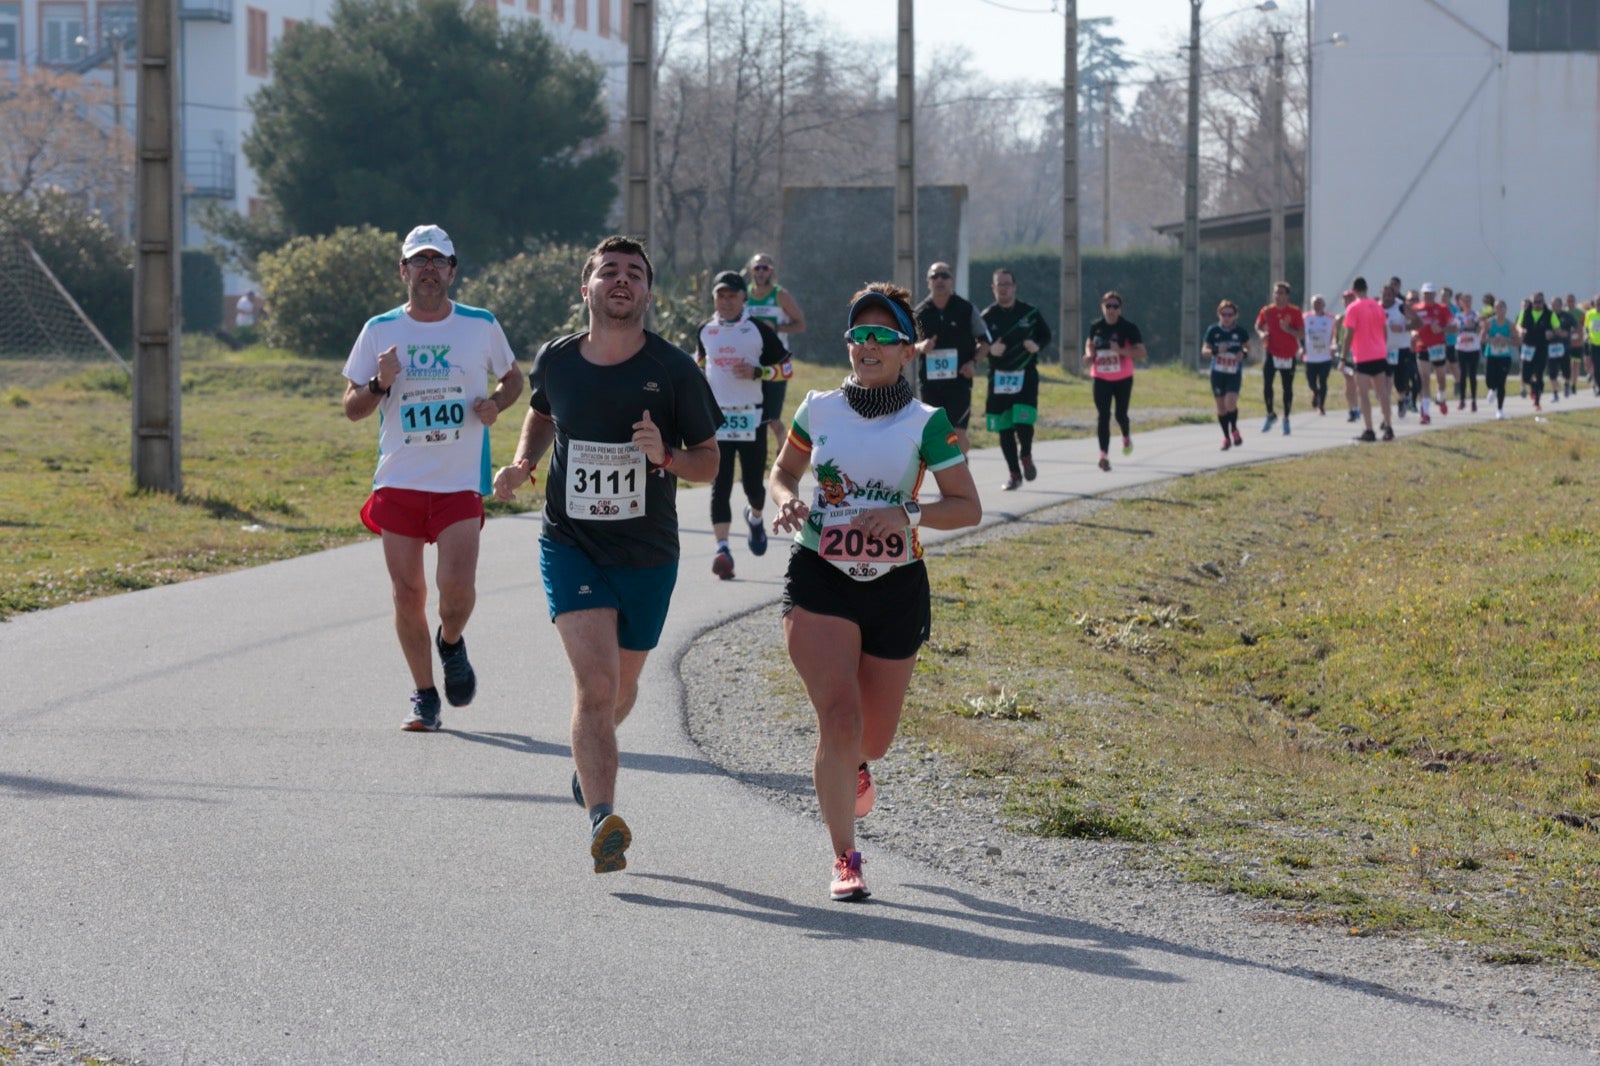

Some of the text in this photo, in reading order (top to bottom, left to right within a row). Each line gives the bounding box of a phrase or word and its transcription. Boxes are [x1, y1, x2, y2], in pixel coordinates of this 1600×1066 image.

[935, 359, 949, 369] 50
[405, 403, 464, 429] 1140
[574, 468, 635, 494] 3111
[866, 480, 881, 489] LA
[844, 508, 859, 517] GRAN
[824, 529, 904, 557] 2059
